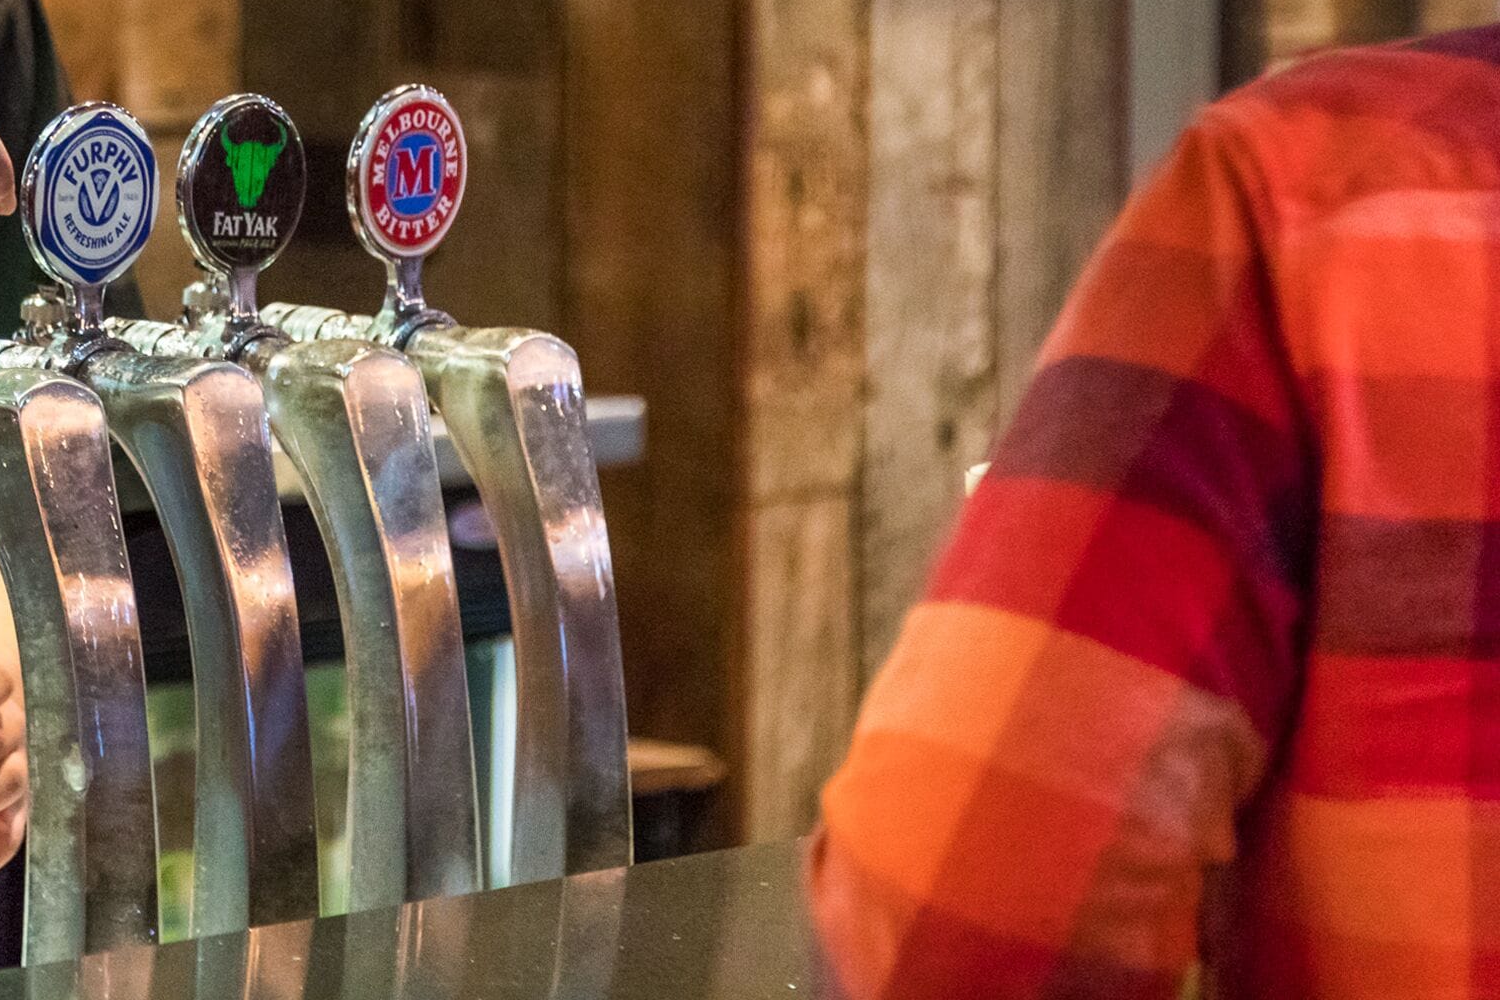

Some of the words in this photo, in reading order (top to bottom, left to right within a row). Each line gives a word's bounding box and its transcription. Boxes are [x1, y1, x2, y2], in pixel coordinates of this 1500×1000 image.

[63, 141, 139, 186] FURPHY
[373, 109, 458, 186] MELBOURNE
[392, 144, 438, 201] M
[63, 212, 114, 250] REFRESHING
[115, 212, 132, 239] ALE
[376, 195, 453, 239] BITTER
